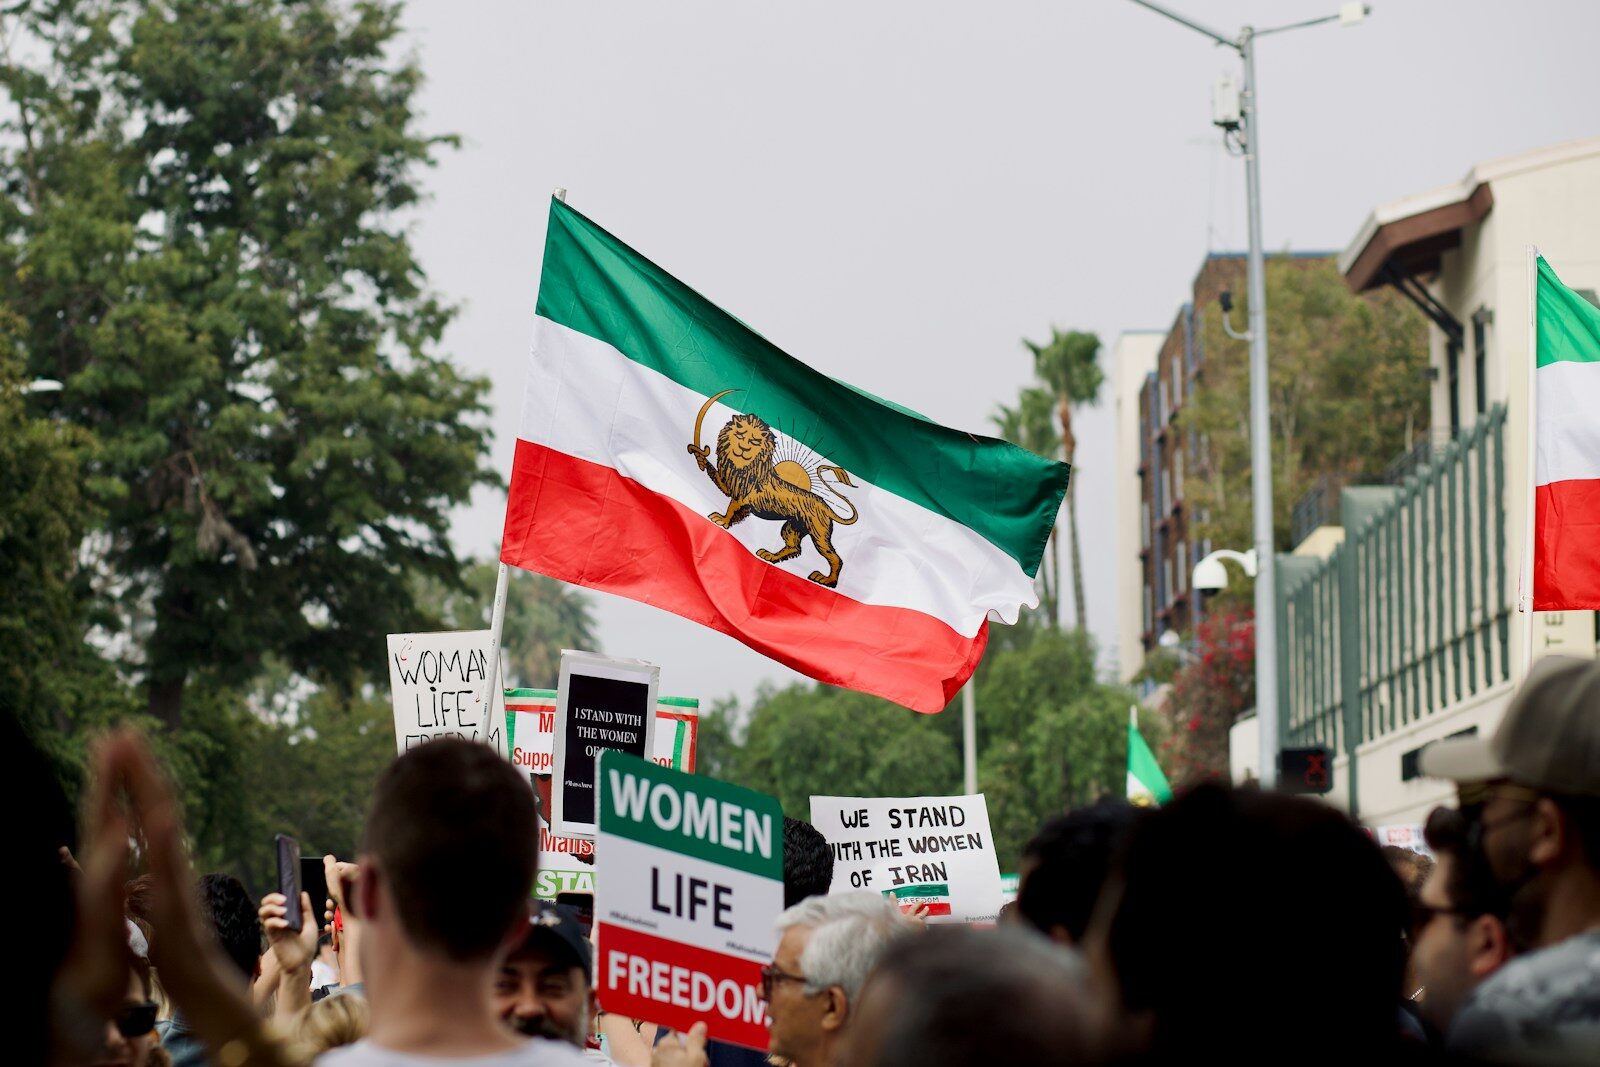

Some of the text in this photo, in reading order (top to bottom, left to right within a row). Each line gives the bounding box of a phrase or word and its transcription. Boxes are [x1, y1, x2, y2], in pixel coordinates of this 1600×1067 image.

[574, 707, 642, 727] I STAND WITH
[577, 726, 638, 744] THE WOMEN
[513, 747, 554, 770] Supp
[608, 768, 772, 859] WOMEN
[840, 805, 966, 829] WE STAND
[865, 839, 903, 859] THE
[907, 832, 984, 854] WOMEN
[850, 861, 949, 889] OF IRAN
[651, 866, 733, 931] LIFE
